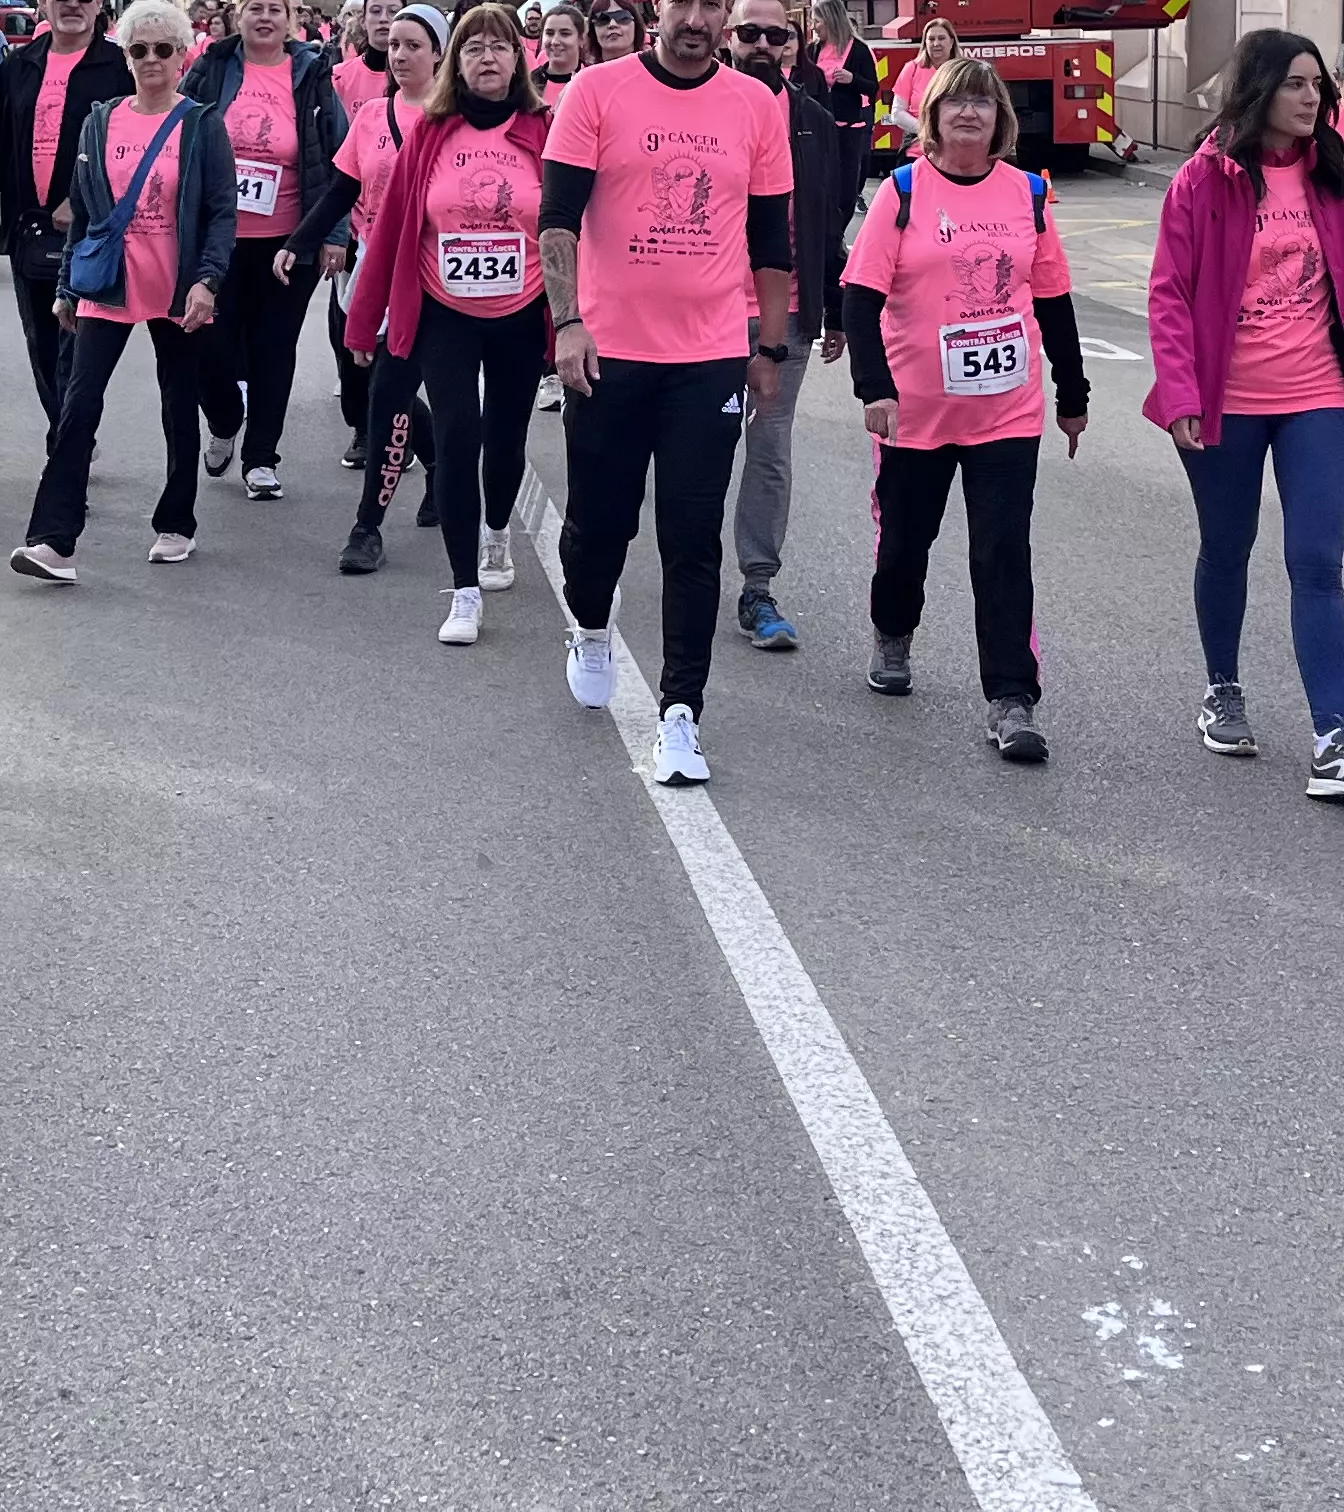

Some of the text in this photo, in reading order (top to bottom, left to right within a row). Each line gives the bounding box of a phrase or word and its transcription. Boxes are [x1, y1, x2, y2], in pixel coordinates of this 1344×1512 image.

[958, 45, 1046, 58] MBEROS
[668, 131, 718, 147] CÁNCER
[474, 150, 517, 163] CÁNCER
[1272, 208, 1311, 220] CÁNCE
[959, 221, 1009, 232] CÁNCER
[487, 244, 517, 252] CÁNCER
[446, 255, 518, 280] 2434
[950, 337, 986, 348] CONTRA
[963, 344, 1016, 378] 543
[378, 413, 410, 507] adidas
